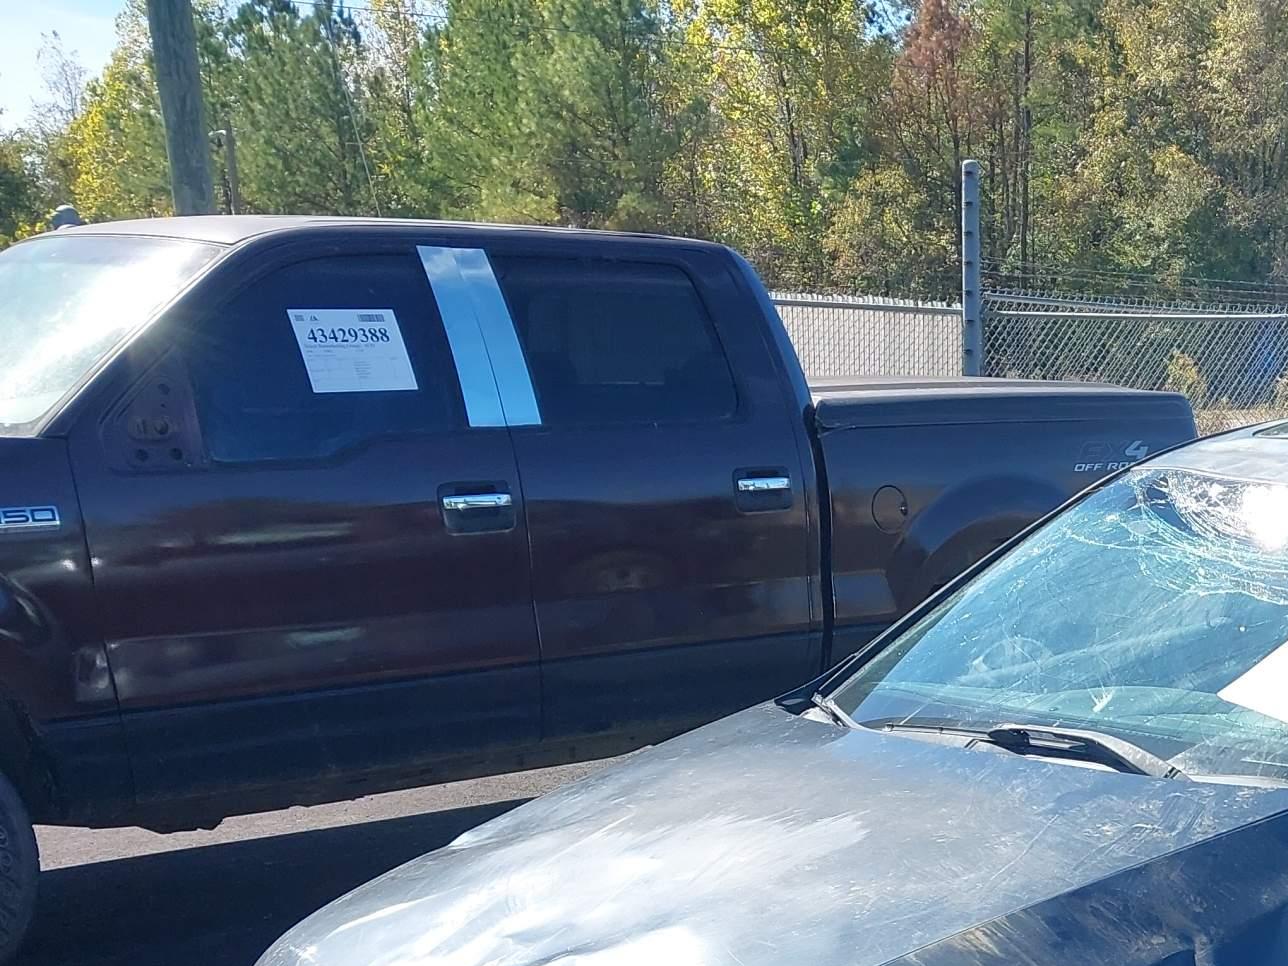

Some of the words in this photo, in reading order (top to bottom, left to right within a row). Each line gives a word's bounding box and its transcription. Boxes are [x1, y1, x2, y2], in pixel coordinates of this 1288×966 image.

[307, 327, 391, 343] 43429388
[1074, 463, 1104, 472] OFF
[1106, 461, 1137, 471] RO
[0, 506, 59, 526] 50
